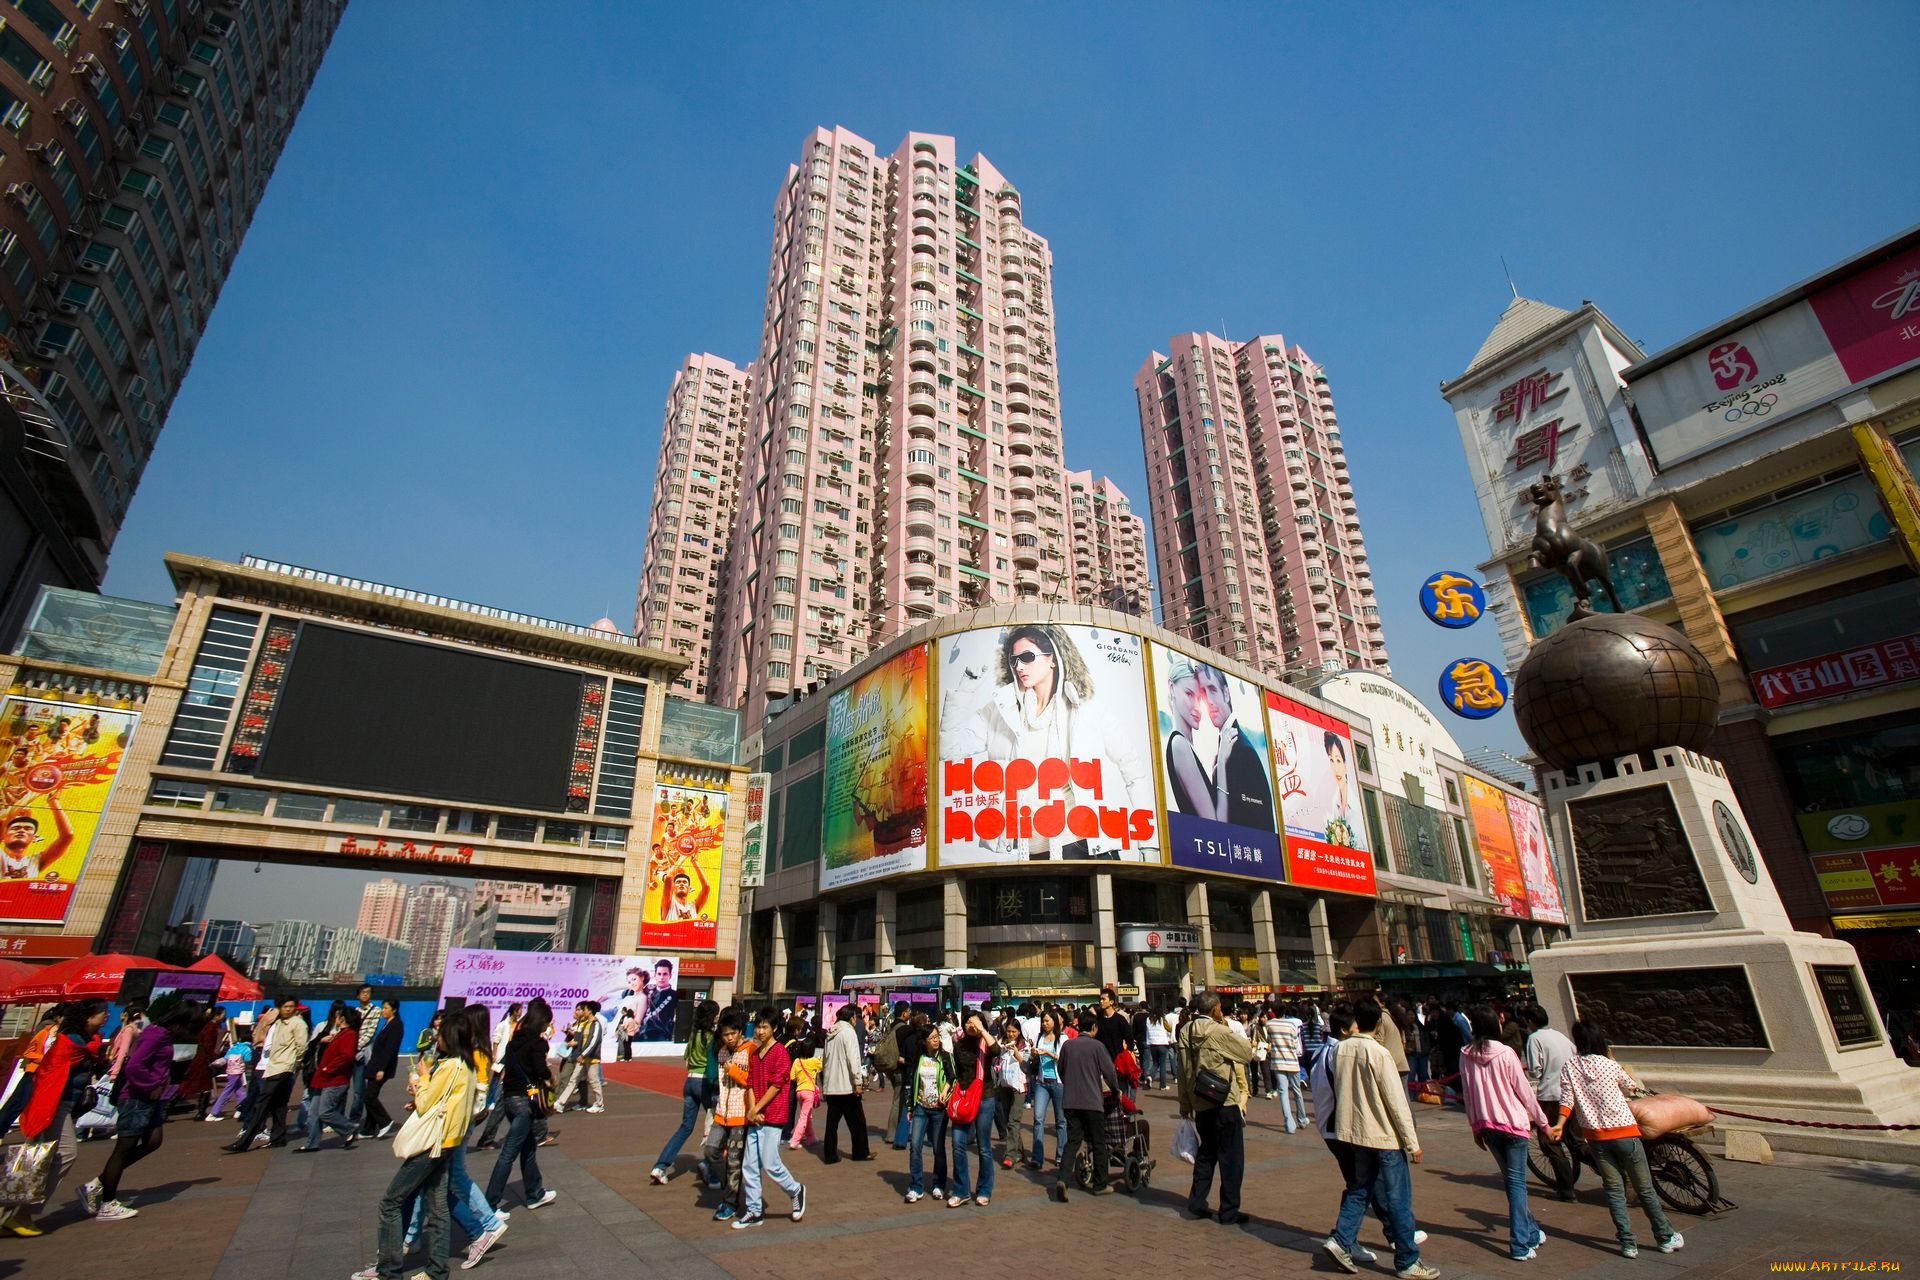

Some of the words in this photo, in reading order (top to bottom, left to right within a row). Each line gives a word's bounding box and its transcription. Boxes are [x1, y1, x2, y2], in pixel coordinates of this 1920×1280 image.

[1703, 390, 1750, 413] Beijing
[1751, 373, 1787, 395] 2008
[1096, 643, 1138, 656] GIORDANO
[944, 757, 1103, 800] Happy
[952, 794, 1000, 809] 节日快乐
[944, 800, 1155, 850] holidays
[1194, 838, 1227, 857] TSL
